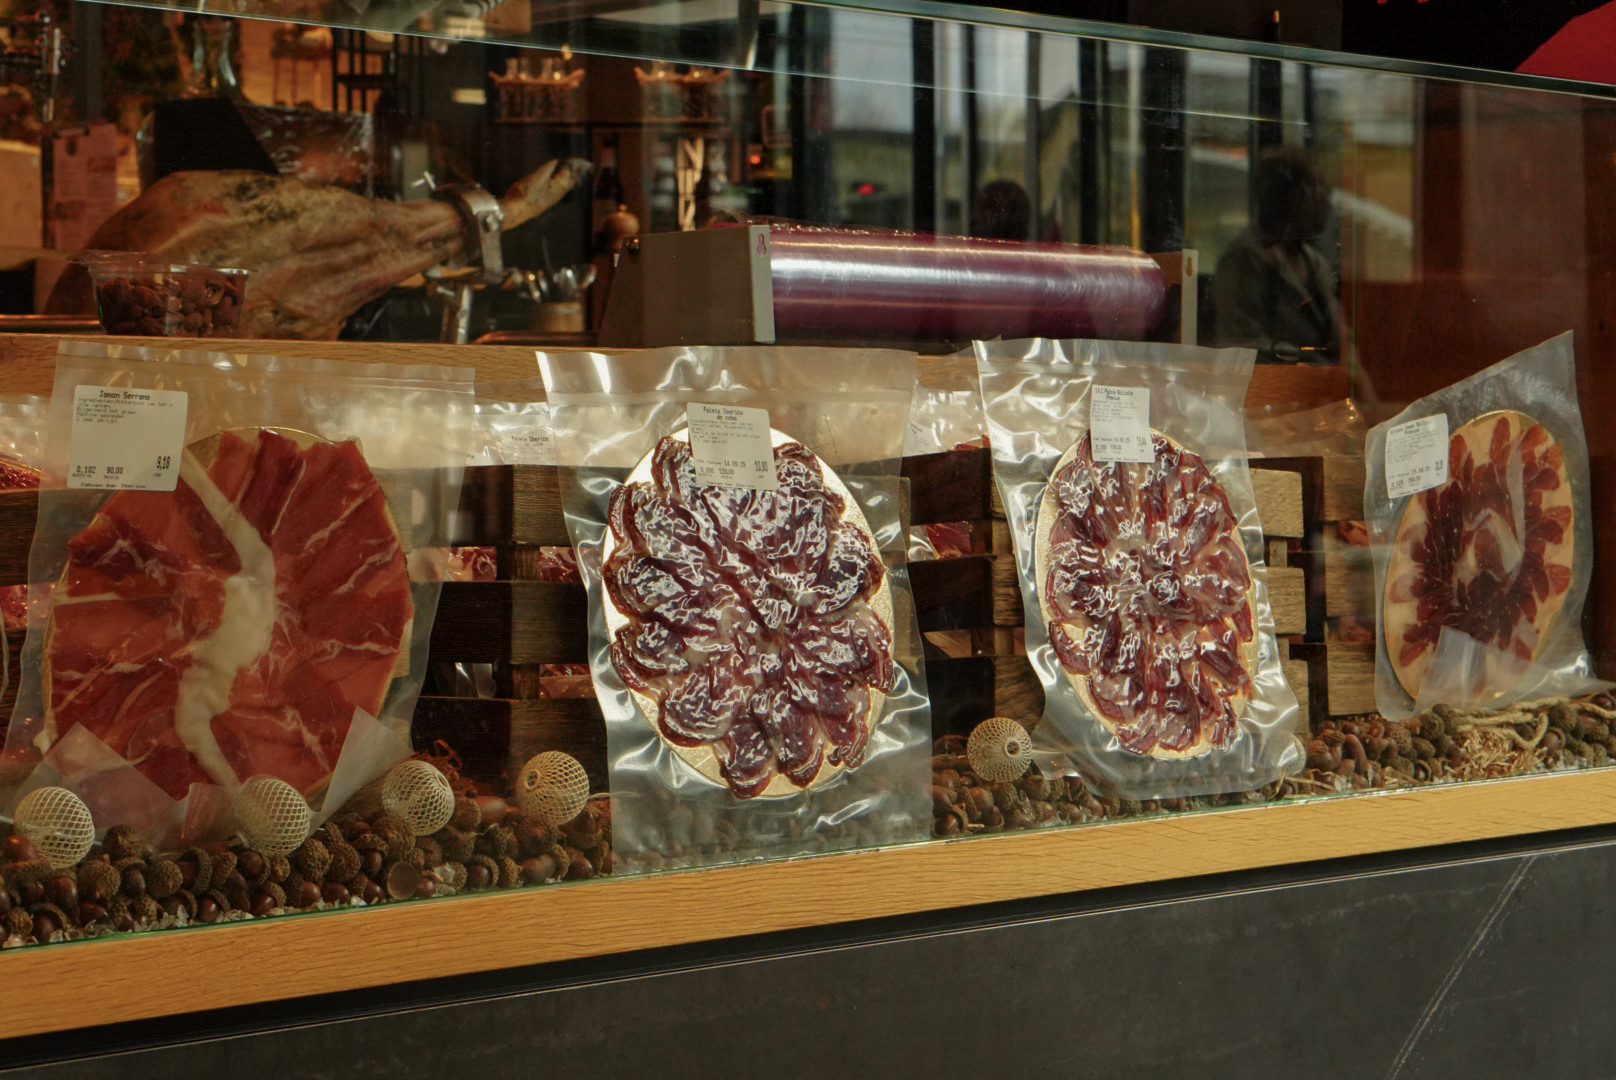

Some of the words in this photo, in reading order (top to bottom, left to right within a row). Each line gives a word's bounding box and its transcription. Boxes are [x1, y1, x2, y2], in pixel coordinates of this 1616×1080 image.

[124, 392, 150, 400] Serrano
[157, 456, 170, 470] 9,18
[77, 466, 95, 474] 0,102
[106, 466, 123, 474] 90,00
